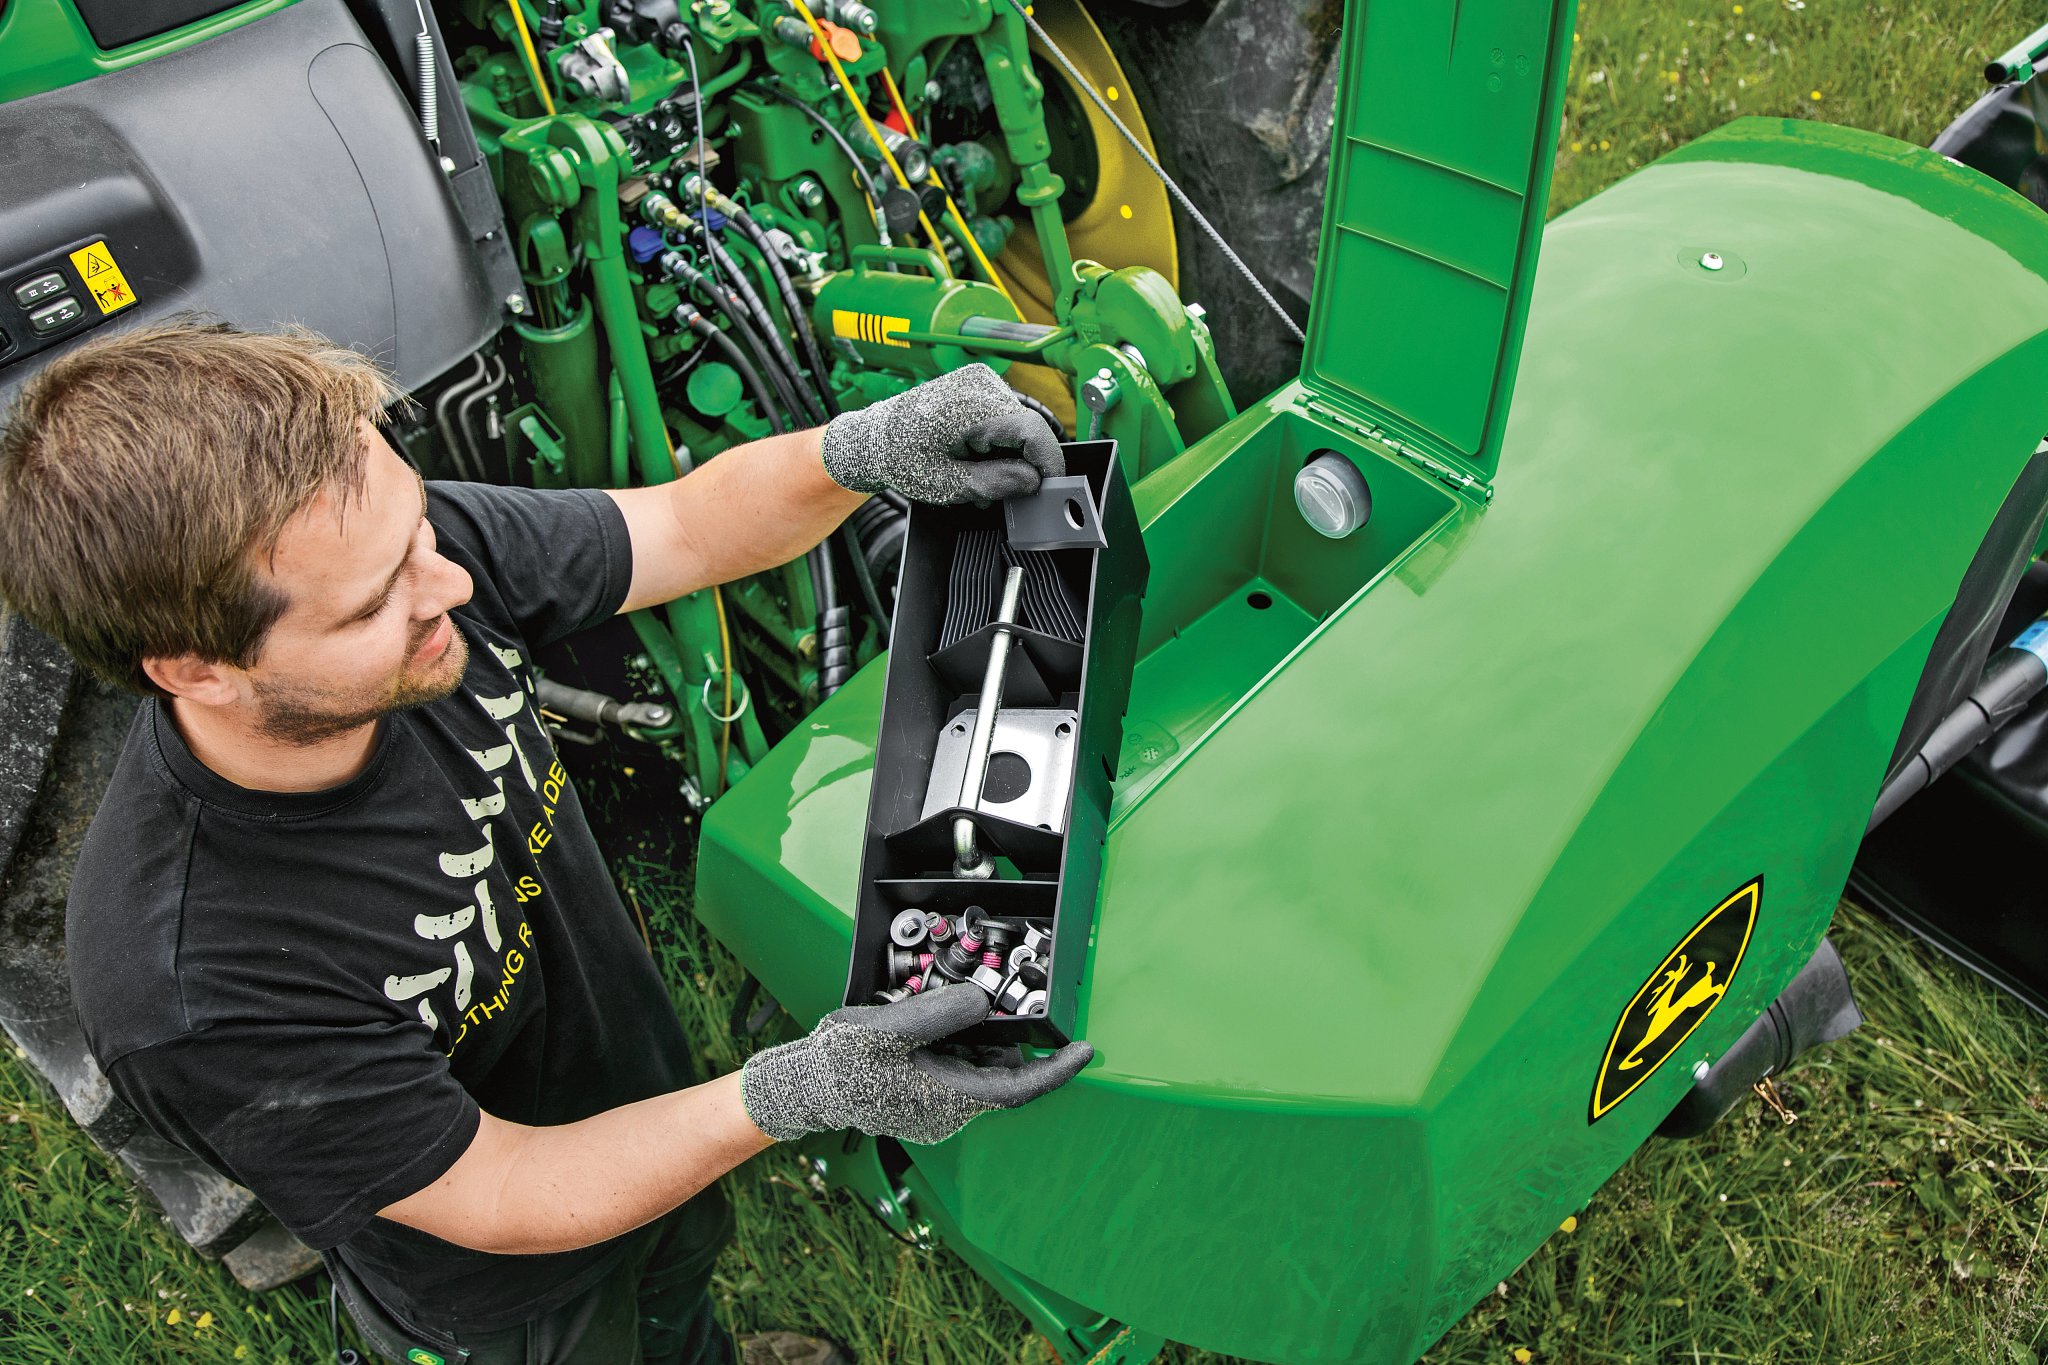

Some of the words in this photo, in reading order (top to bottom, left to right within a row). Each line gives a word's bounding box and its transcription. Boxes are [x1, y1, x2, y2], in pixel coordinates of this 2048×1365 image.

[543, 757, 567, 805] DE
[543, 804, 555, 826] A
[514, 875, 542, 948] RNS
[447, 949, 525, 1058] OTHING
